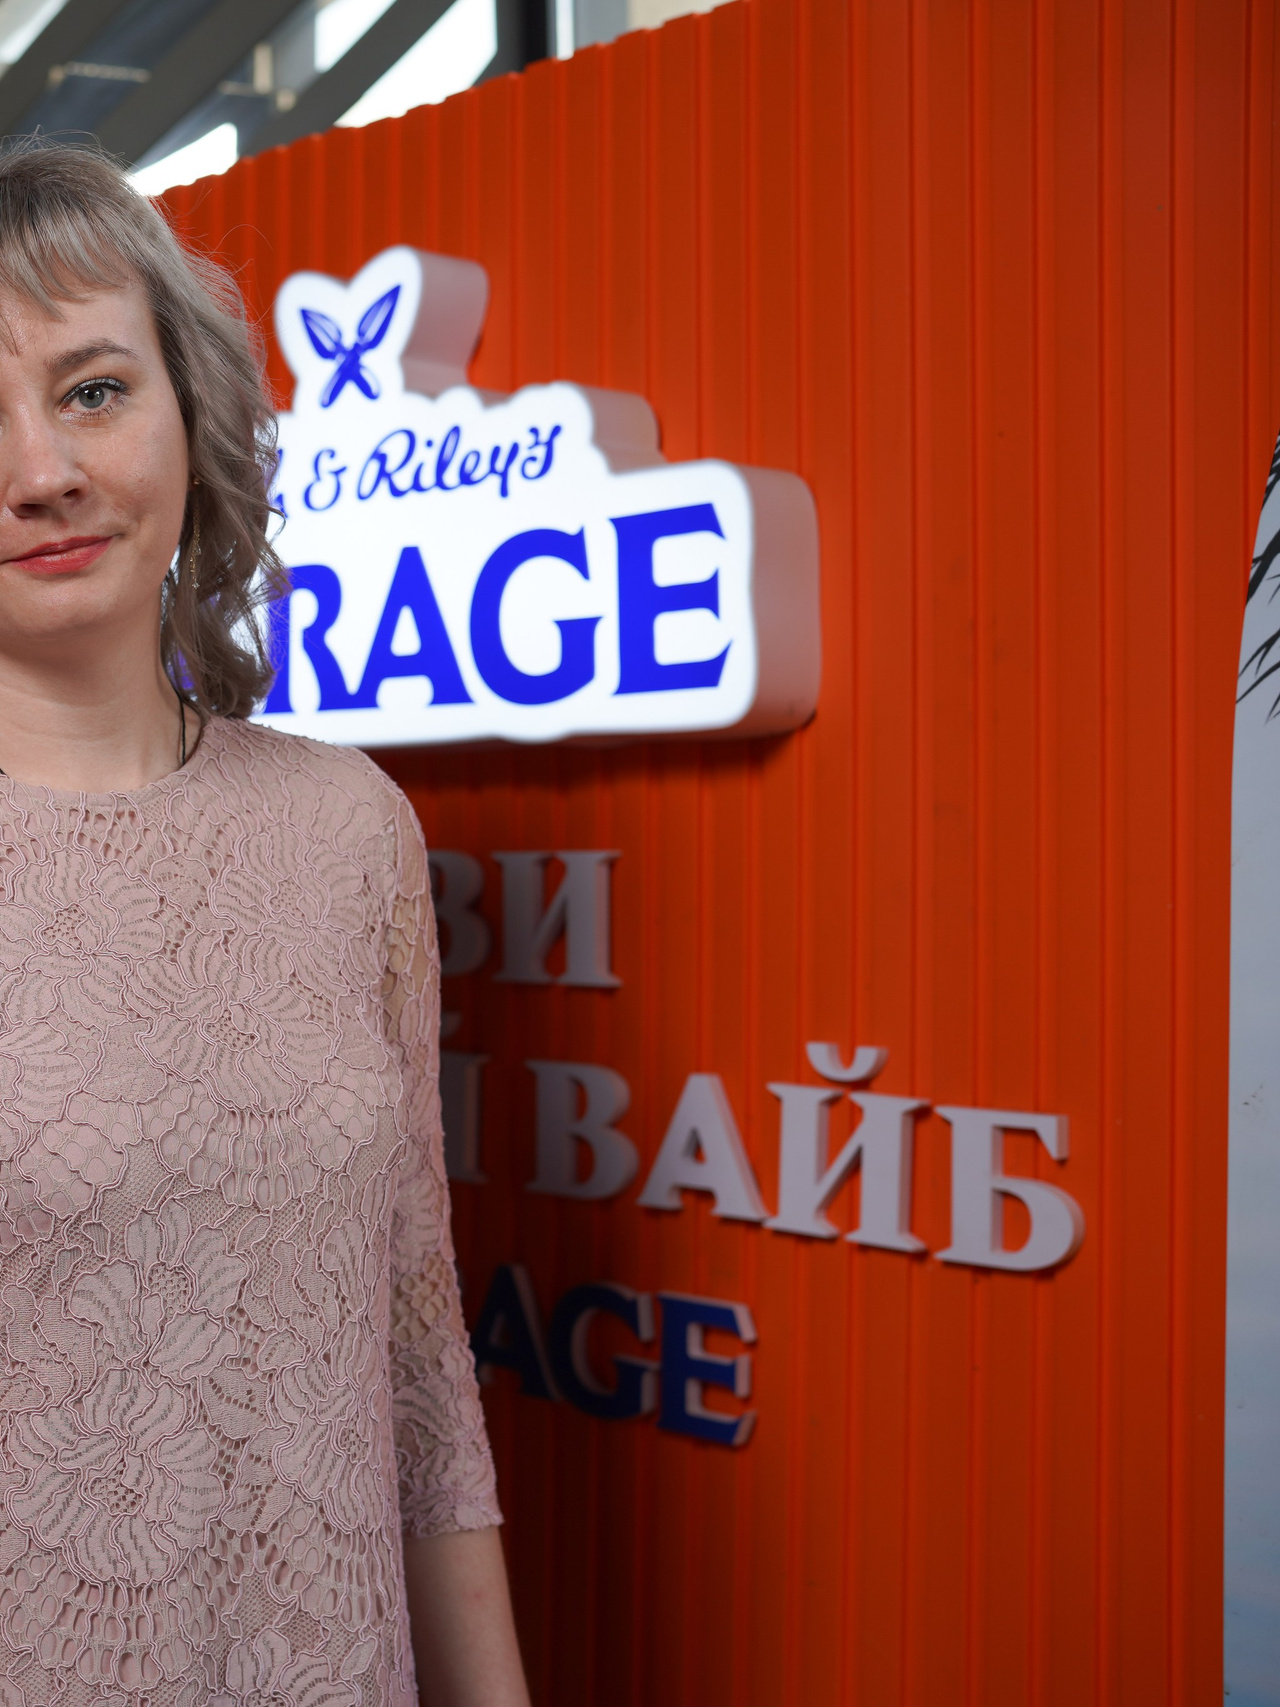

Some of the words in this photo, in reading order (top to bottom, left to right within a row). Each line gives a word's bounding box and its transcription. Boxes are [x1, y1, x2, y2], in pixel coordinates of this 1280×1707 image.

[304, 449, 347, 511] &
[357, 425, 561, 500] Riley's
[168, 503, 734, 714] RAGE
[524, 1041, 1085, 1272] ВАЙБ
[458, 1262, 758, 1446] AGE
